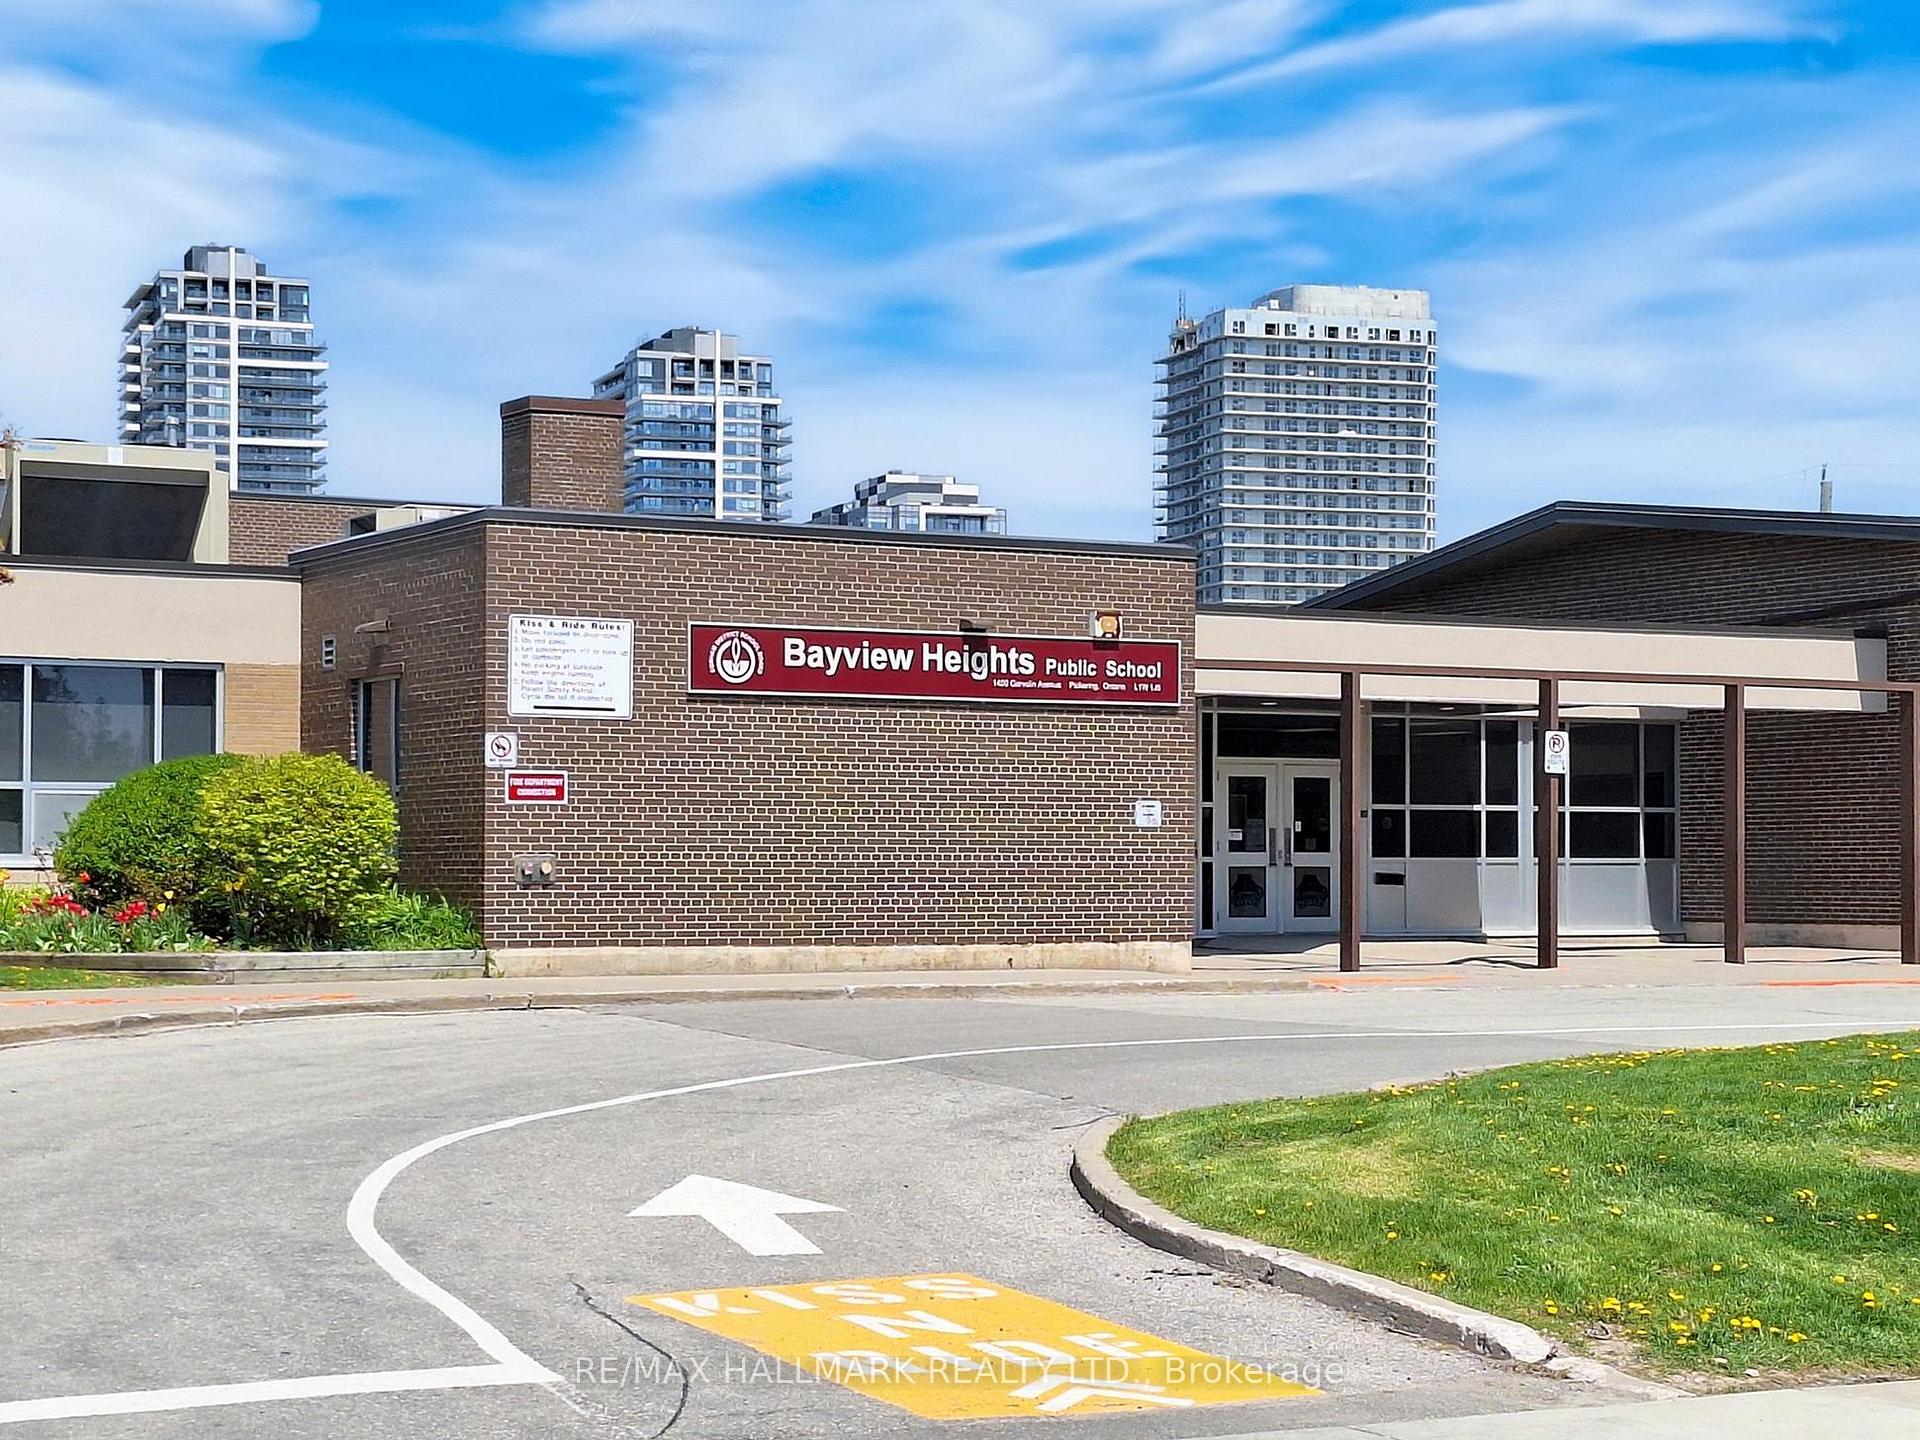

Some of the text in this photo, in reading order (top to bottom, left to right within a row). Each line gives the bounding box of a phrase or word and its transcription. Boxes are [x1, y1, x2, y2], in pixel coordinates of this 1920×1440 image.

[520, 619, 543, 628] Kiss
[562, 622, 586, 630] Ride
[783, 637, 1162, 680] Bayview Heights Public School
[836, 1309, 976, 1339] N
